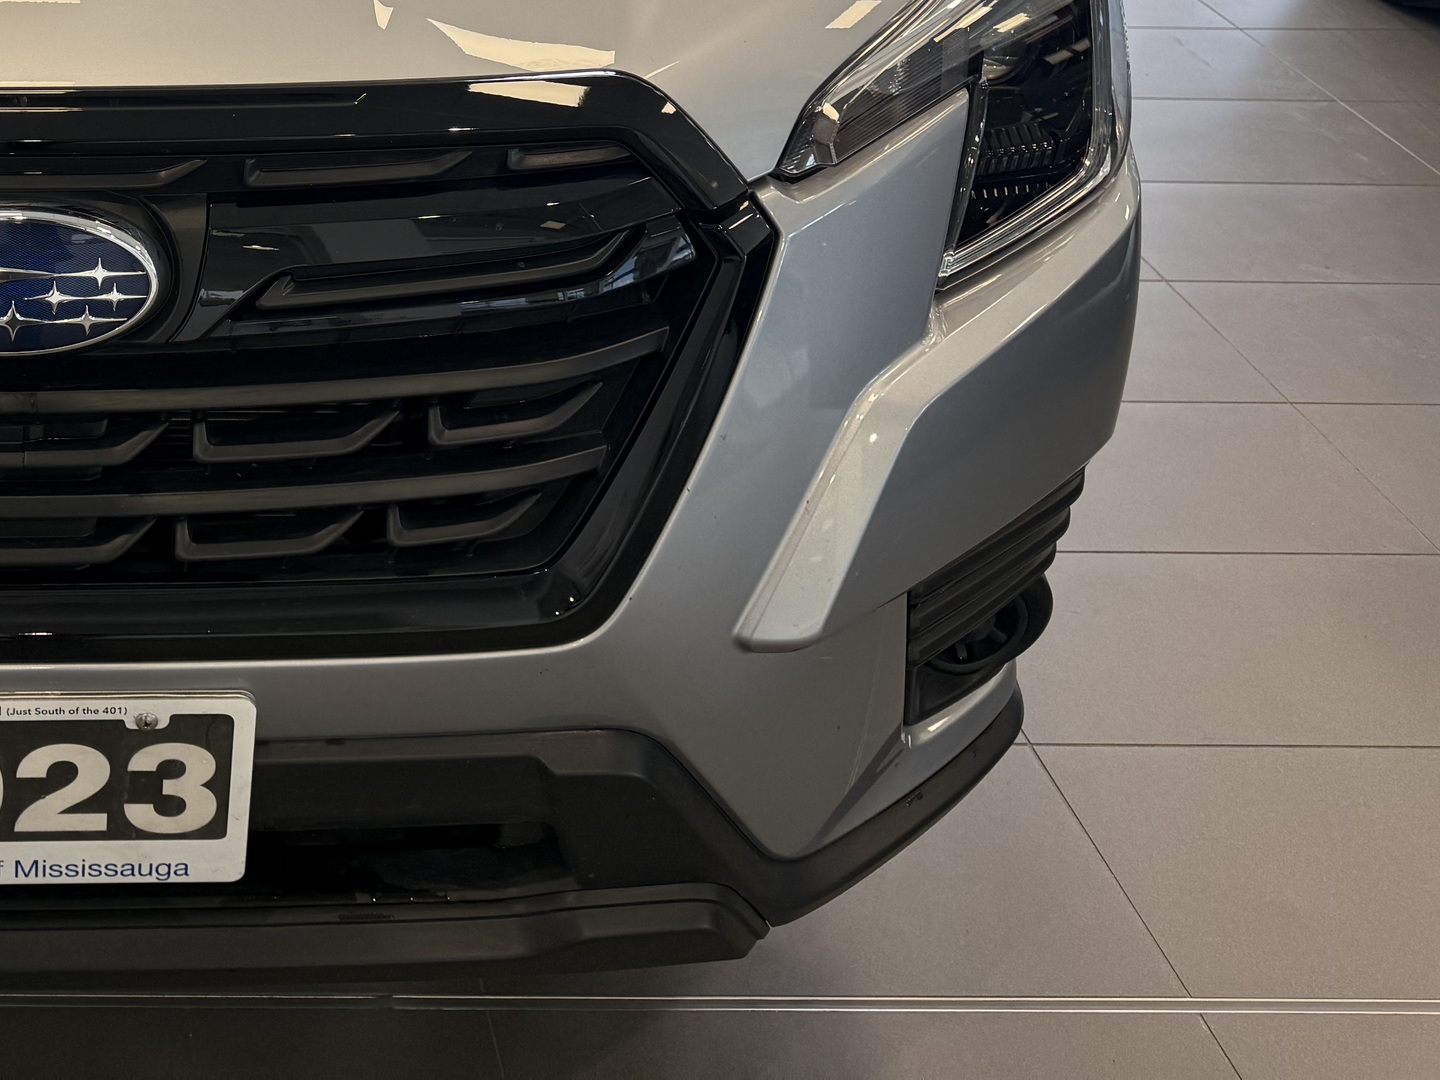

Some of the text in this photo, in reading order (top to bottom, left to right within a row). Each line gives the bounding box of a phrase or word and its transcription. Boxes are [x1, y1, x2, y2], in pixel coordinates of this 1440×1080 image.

[6, 707, 32, 717] (Just
[34, 707, 66, 716] South
[68, 706, 80, 715] of
[82, 706, 100, 715] the
[102, 706, 128, 716] 401)
[14, 859, 190, 881] Mississauga
